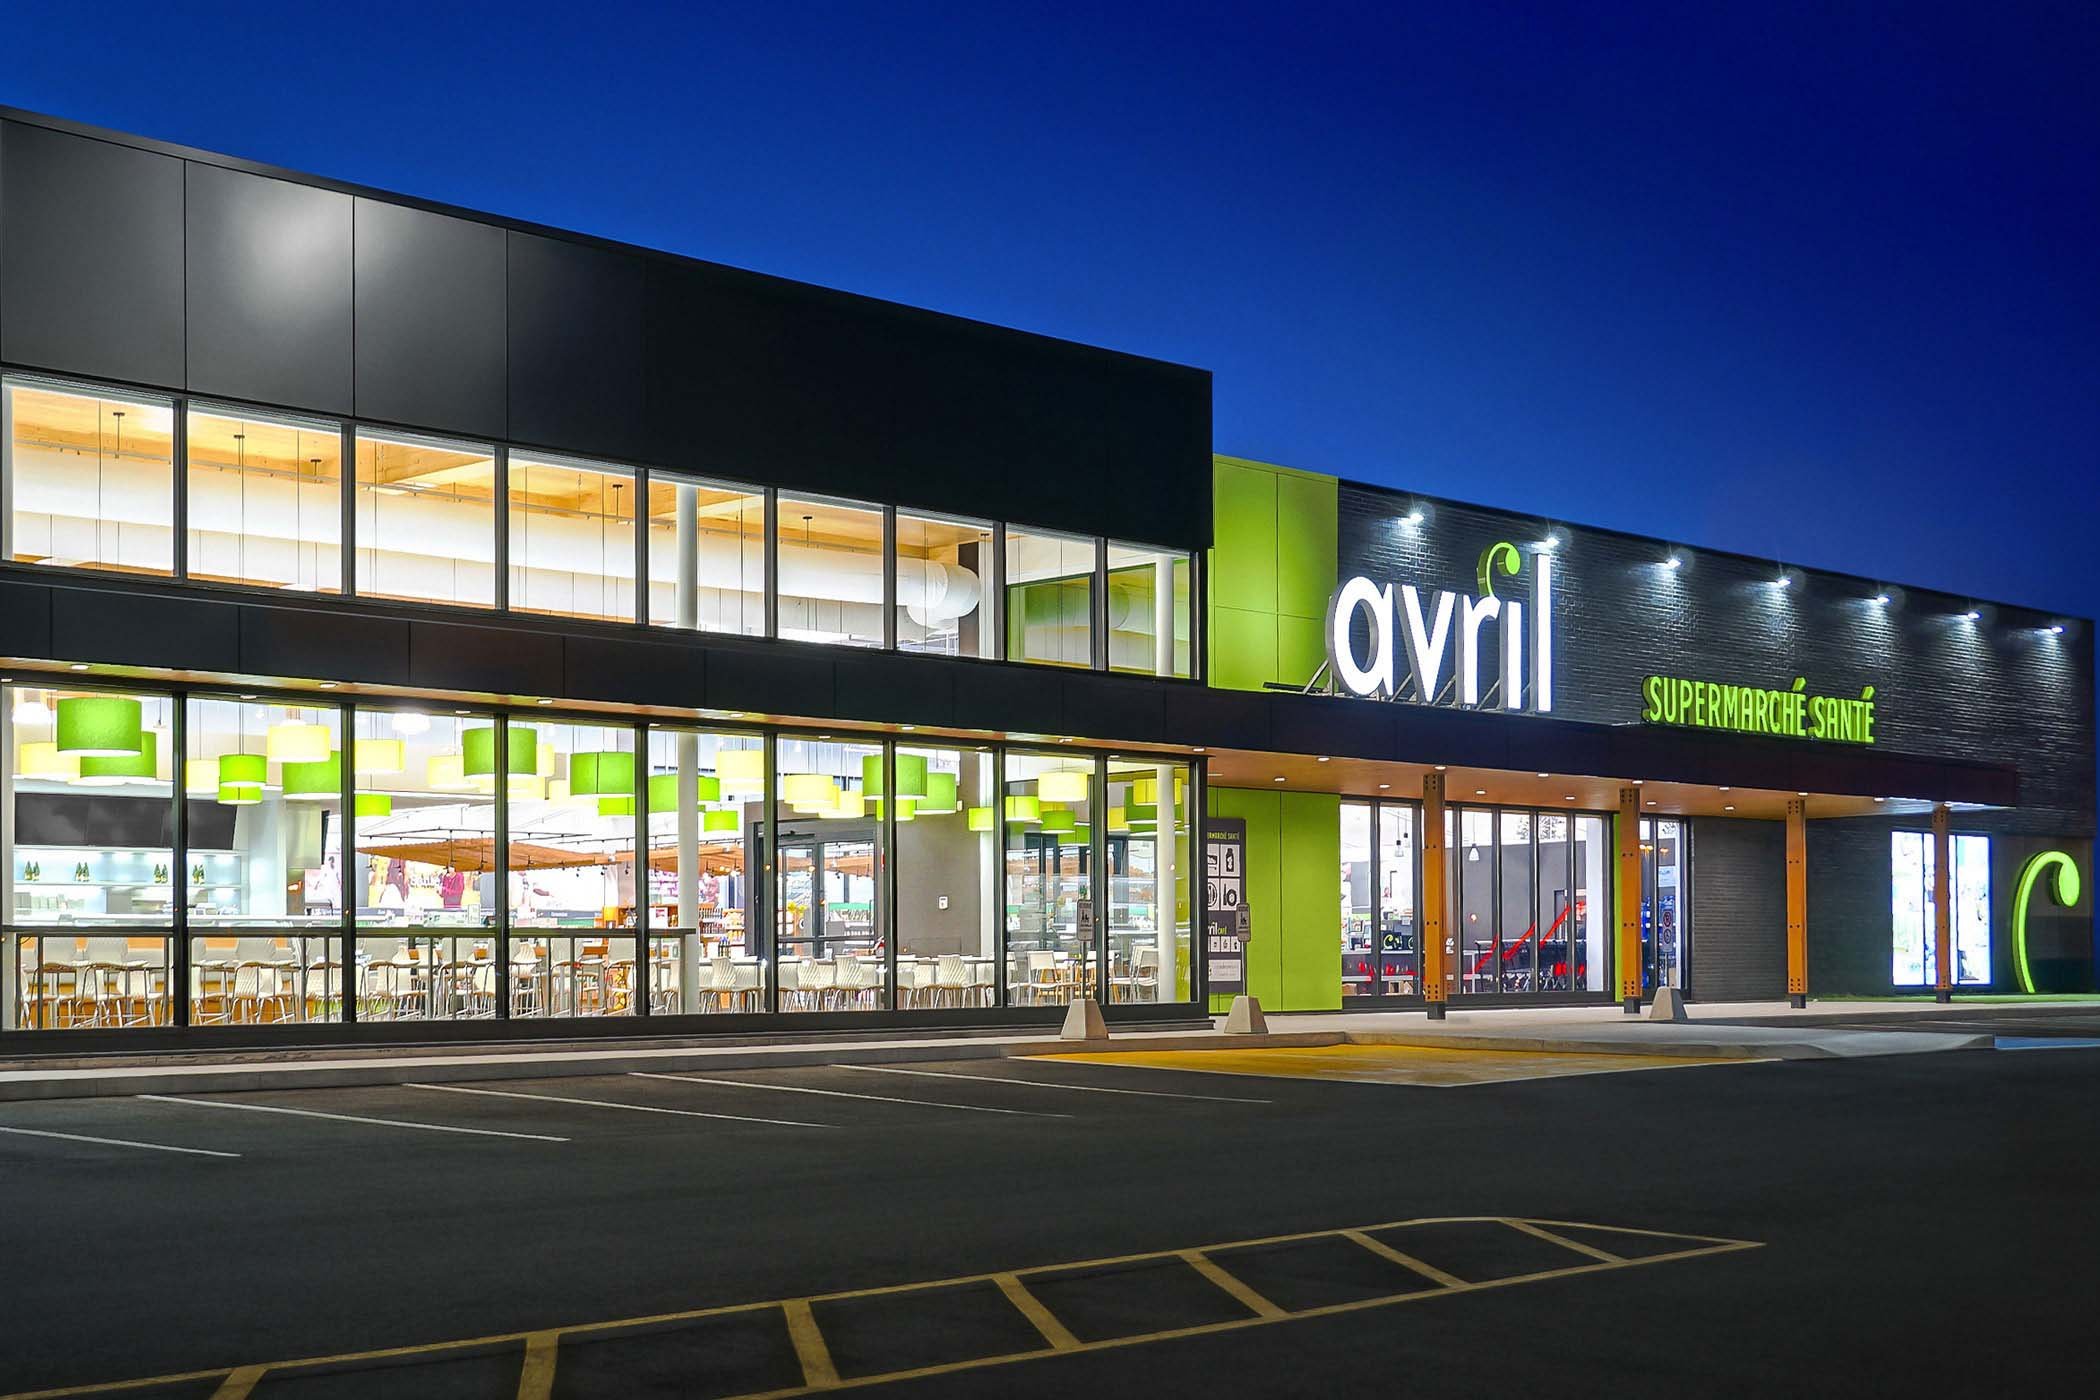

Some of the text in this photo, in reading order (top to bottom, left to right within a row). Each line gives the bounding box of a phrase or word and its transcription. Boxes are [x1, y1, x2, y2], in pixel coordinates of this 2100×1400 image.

[1327, 542, 1552, 712] avril
[1643, 676, 1874, 743] SUPERMARCHÉ SANTÉ
